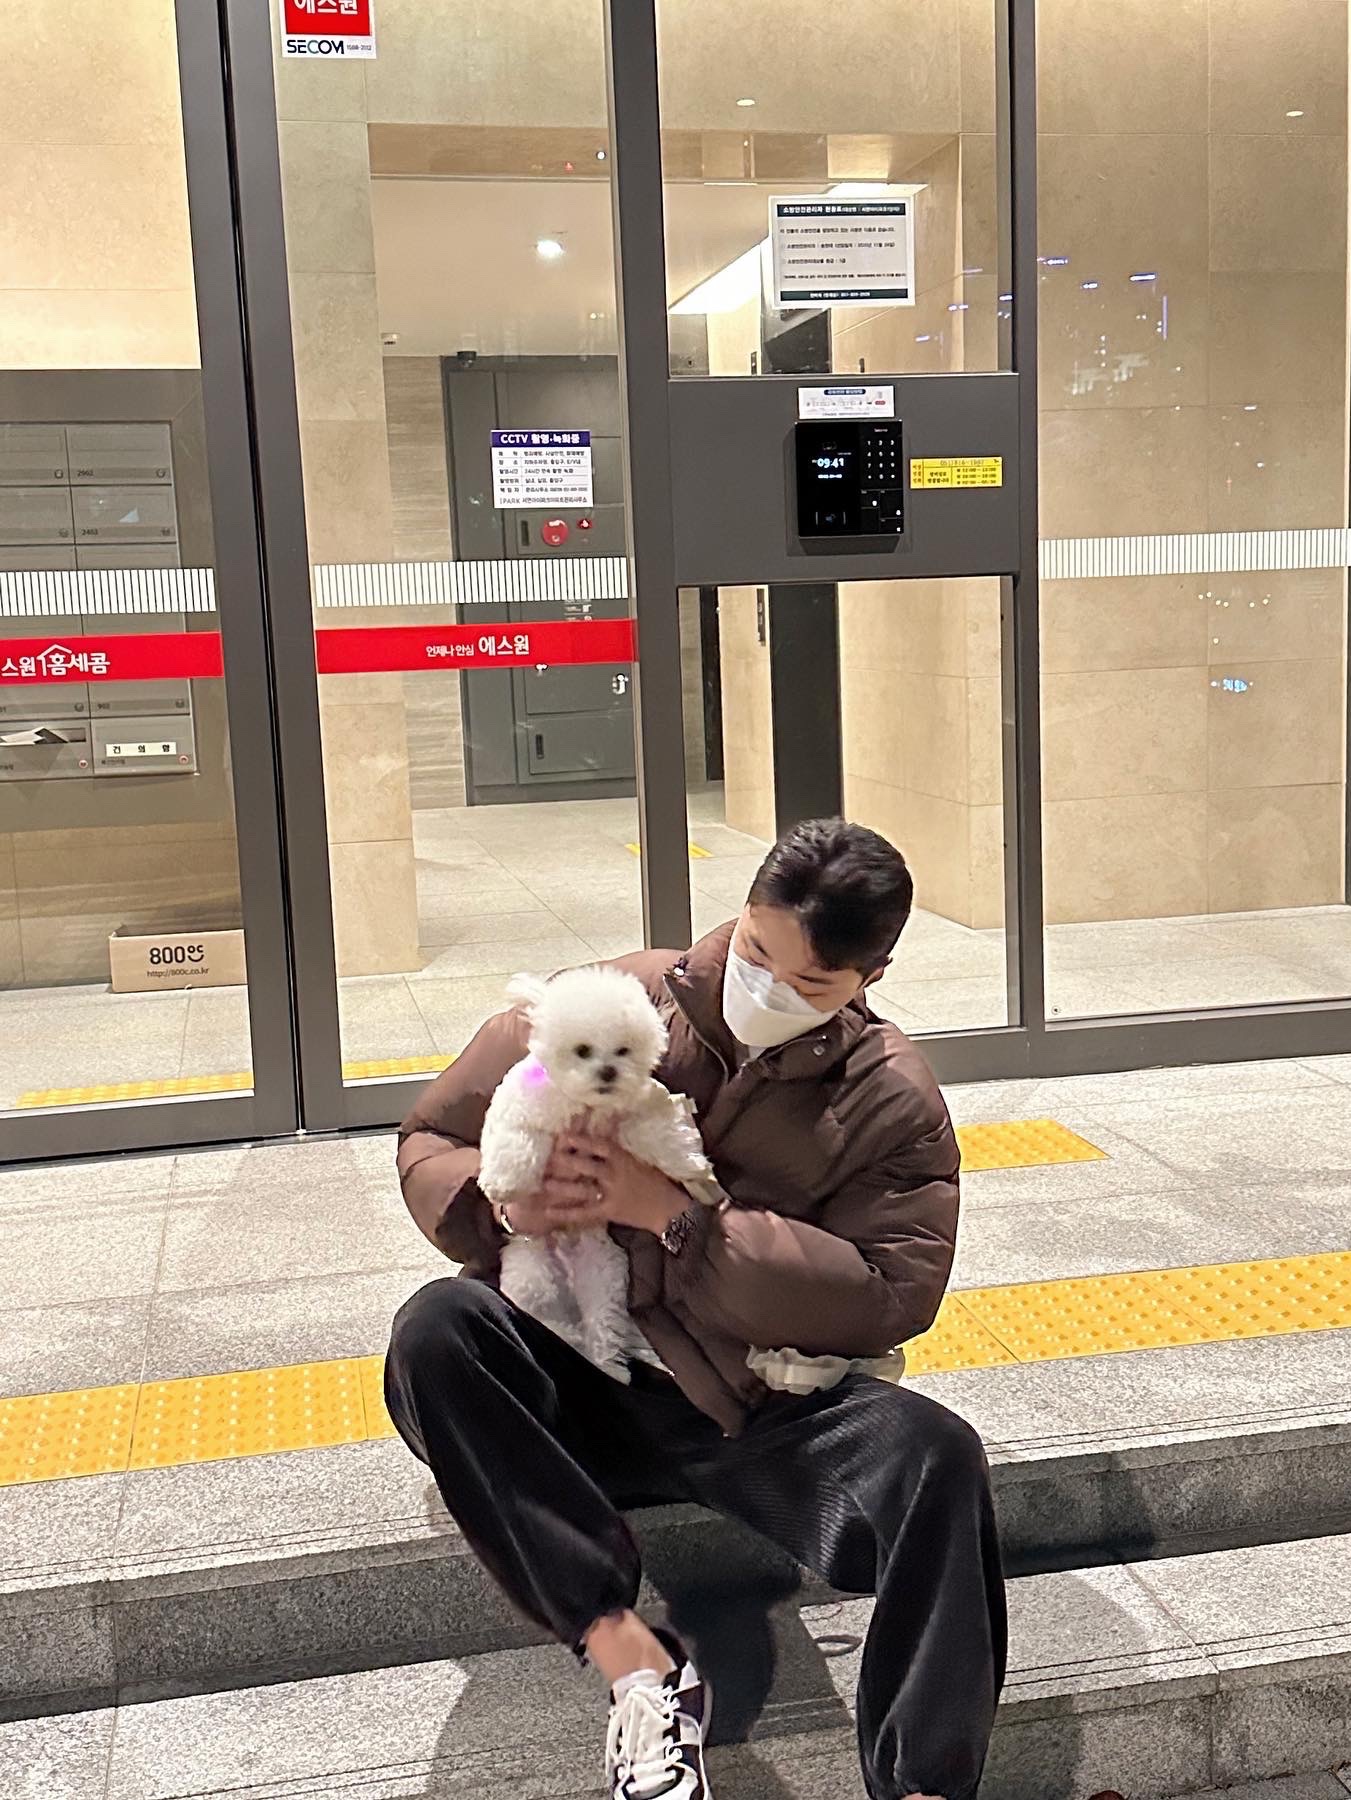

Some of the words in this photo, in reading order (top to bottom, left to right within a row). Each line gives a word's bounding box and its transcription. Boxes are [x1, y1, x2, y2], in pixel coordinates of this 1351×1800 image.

[287, 40, 345, 54] SECOM
[500, 434, 529, 444] CCTV
[426, 645, 455, 657] 언제나
[456, 645, 474, 656] 안심
[478, 635, 530, 656] 에스원
